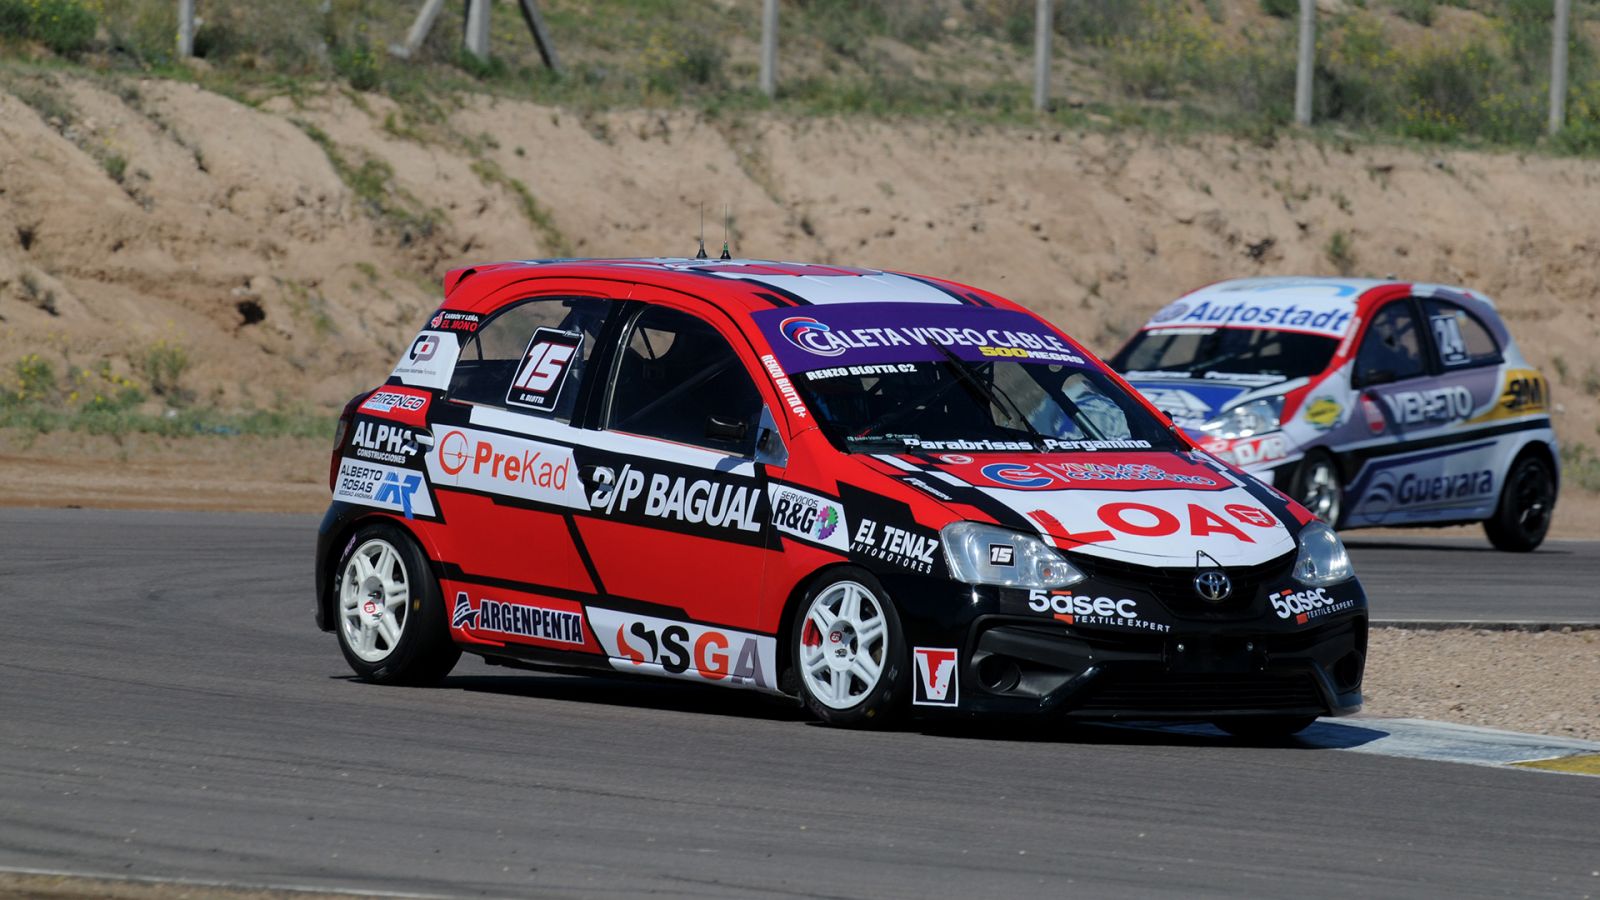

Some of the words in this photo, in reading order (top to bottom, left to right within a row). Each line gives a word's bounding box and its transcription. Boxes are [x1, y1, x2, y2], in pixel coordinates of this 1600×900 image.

[441, 320, 451, 329] EL
[451, 321, 479, 332] MONO
[1183, 302, 1351, 332] Autostadt
[805, 327, 911, 351] CALETA
[900, 327, 988, 347] VIDEO
[986, 329, 1073, 354] CABLE
[514, 342, 575, 393] 15
[761, 354, 785, 378] RENZO
[775, 378, 802, 407] BLOTTA
[805, 367, 849, 381] RENZO
[848, 365, 899, 376] BLOTTA
[897, 363, 918, 373] C2
[352, 421, 418, 456] ALPHA
[904, 438, 1034, 451] Parabrisas
[1043, 438, 1152, 452] Pergamino
[356, 448, 406, 464] CONSTRUCCIONES
[473, 441, 570, 492] PreKad
[341, 464, 383, 481] ALBERTO
[342, 478, 374, 493] ROSAS
[1399, 469, 1493, 504] Guevara
[644, 473, 762, 533] BAGUAL
[780, 490, 819, 508] SERVICIOS
[772, 498, 818, 535] R&G
[1026, 502, 1257, 550] LOA
[854, 518, 877, 546] EL
[882, 525, 939, 564] TENAZ
[991, 547, 1013, 563] 15
[849, 542, 932, 574] AUTOMOTORES
[479, 600, 585, 643] ARGENPENTA
[1074, 614, 1124, 626] TEXTILE
[1127, 618, 1171, 633] EXPERT
[1306, 606, 1332, 619] TEXTILE
[1331, 599, 1354, 612] EXPERT
[660, 624, 768, 688] SGA
